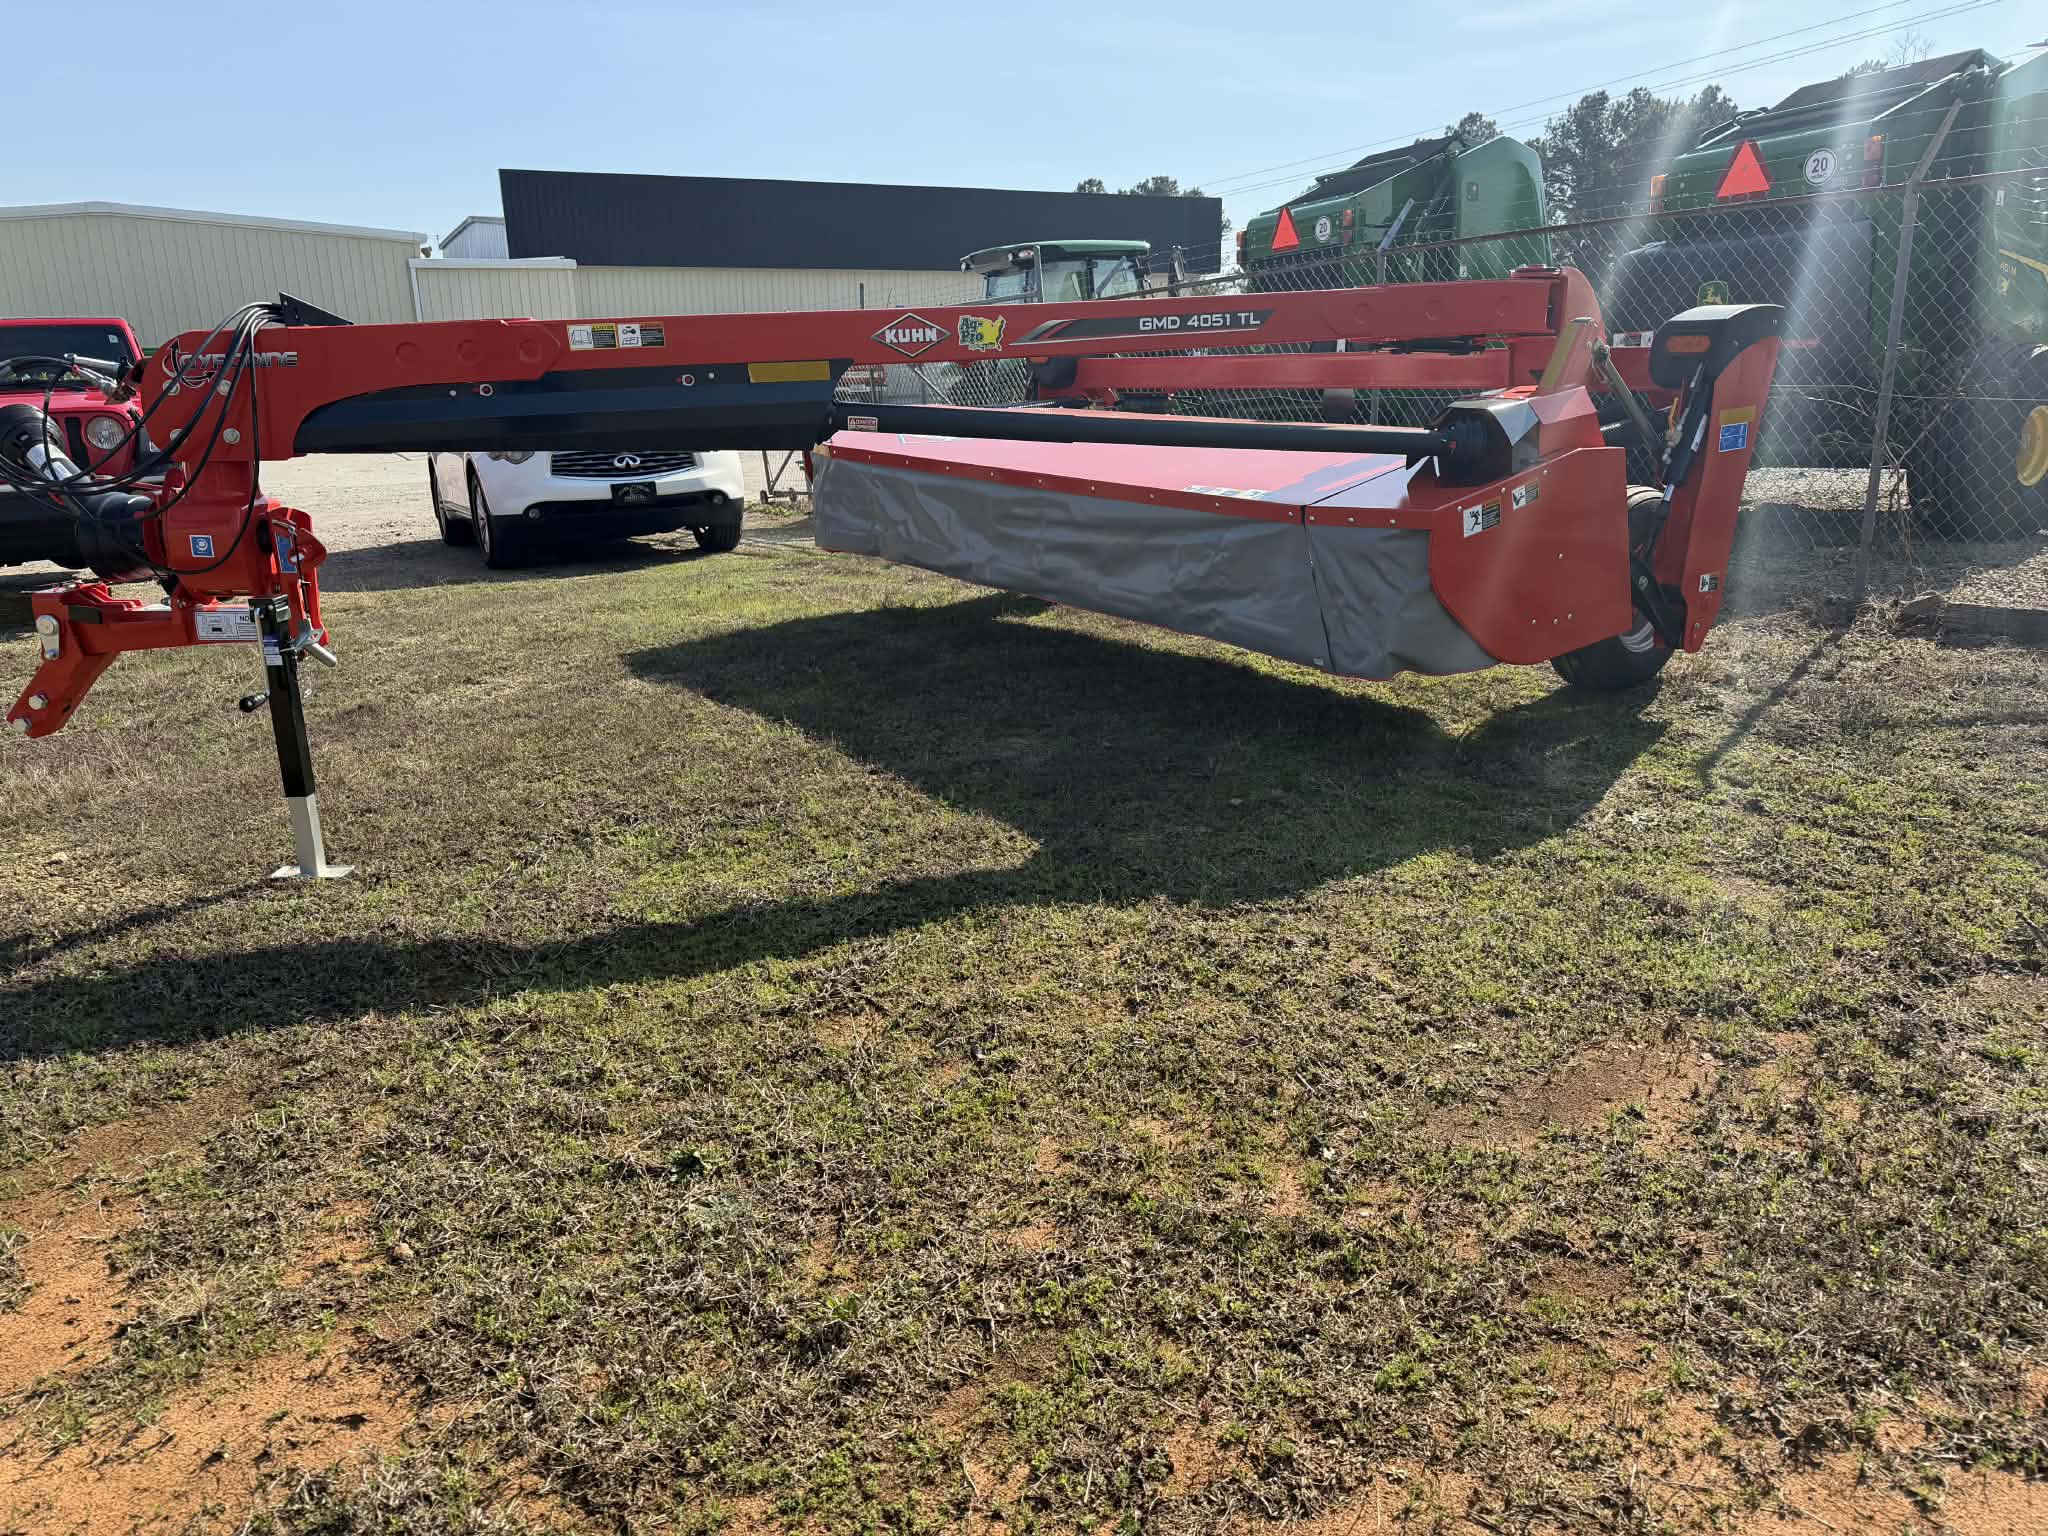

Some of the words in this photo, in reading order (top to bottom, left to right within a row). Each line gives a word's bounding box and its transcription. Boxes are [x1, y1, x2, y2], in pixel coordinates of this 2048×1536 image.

[1811, 157, 1828, 173] 20
[1319, 222, 1328, 233] 20
[1140, 316, 1180, 330] GMD
[1186, 313, 1231, 327] 4051
[1237, 312, 1260, 325] TL
[885, 327, 937, 344] KUHN
